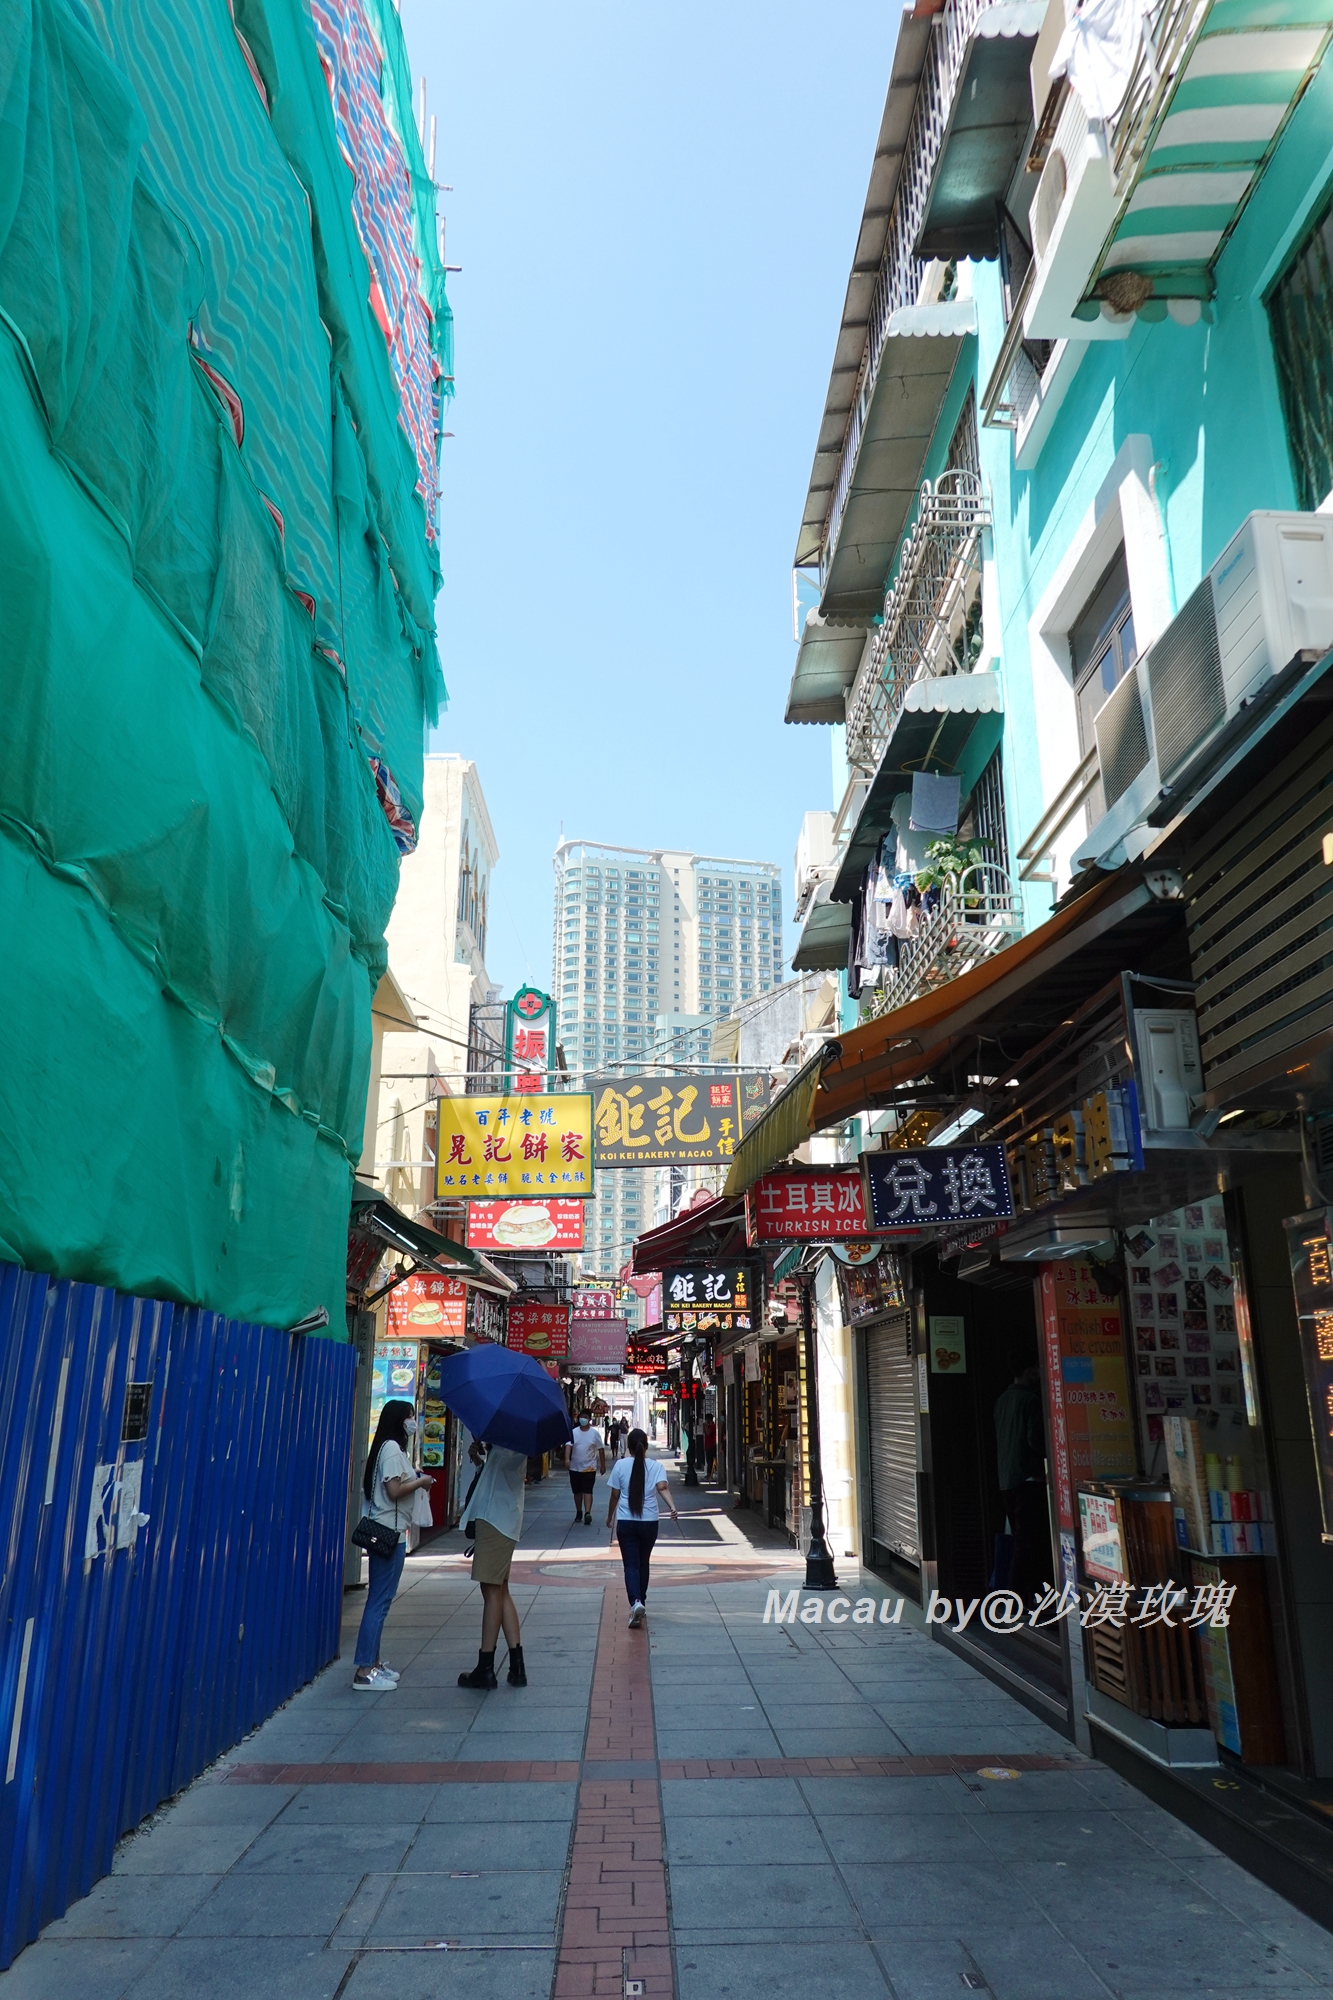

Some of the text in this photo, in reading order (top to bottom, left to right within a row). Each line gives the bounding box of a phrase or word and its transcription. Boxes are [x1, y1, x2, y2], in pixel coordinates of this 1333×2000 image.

[475, 1108, 557, 1127] 百年老號
[594, 1084, 711, 1148] 鉅記
[717, 1117, 735, 1156] 手信
[445, 1131, 586, 1166] 晃記餅家
[600, 1149, 713, 1161] KOI KEI BAKERY MACAO
[760, 1180, 861, 1214] 土耳其冰
[765, 1220, 830, 1234] TURKISH
[412, 1280, 464, 1297] 梁錦記
[669, 1273, 732, 1302] 鉅記
[735, 1271, 745, 1292] 手信
[527, 1312, 567, 1325] 梁錦記
[1061, 1317, 1101, 1336] Turkish
